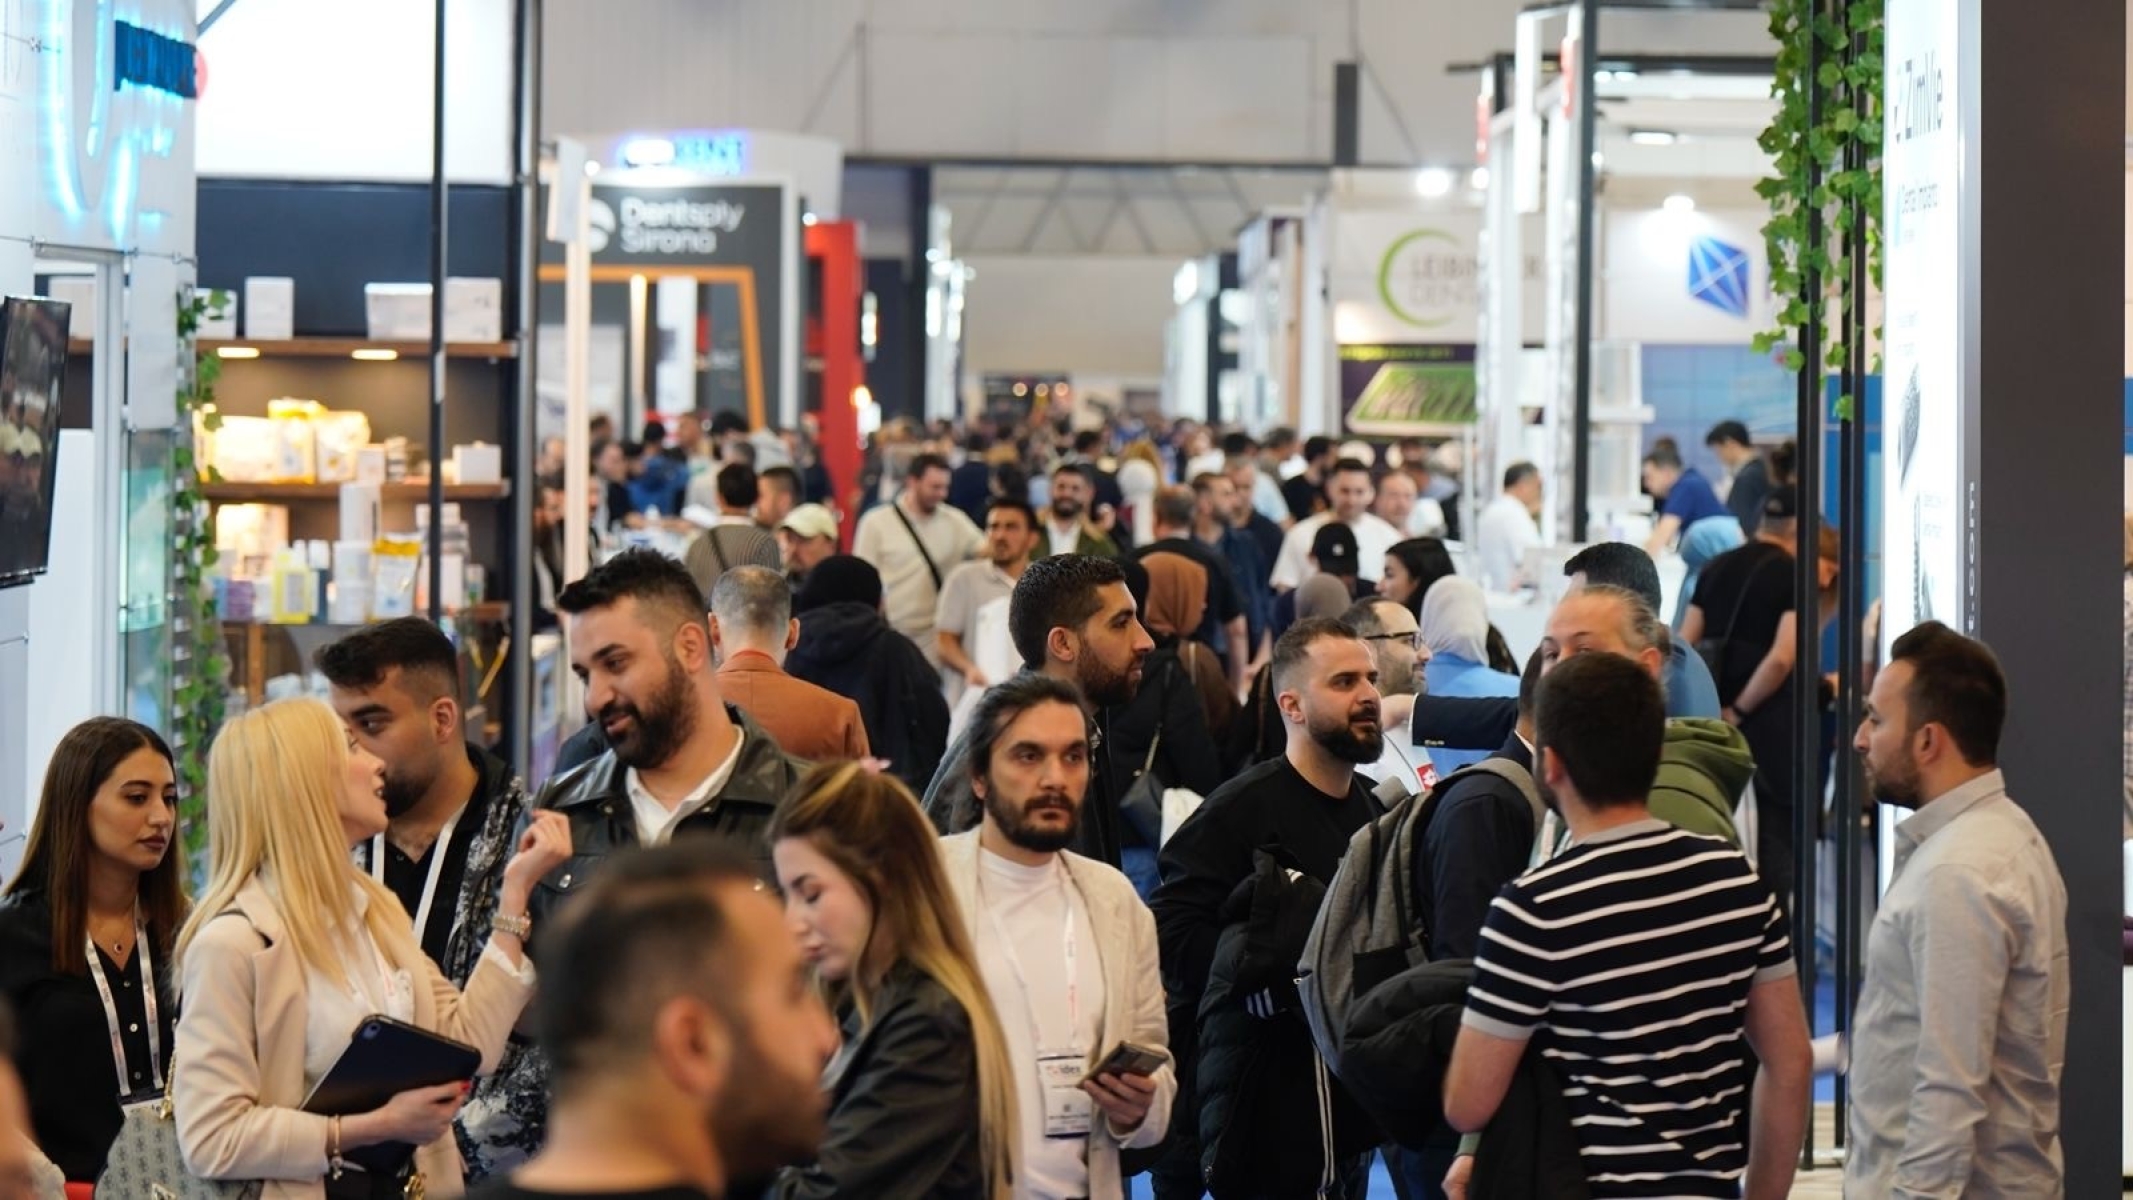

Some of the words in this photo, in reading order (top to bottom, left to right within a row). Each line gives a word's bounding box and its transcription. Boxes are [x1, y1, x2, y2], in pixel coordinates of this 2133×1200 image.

[1905, 50, 1943, 139] ZimVie
[620, 198, 745, 232] Dentsply
[620, 228, 717, 253] Sirona
